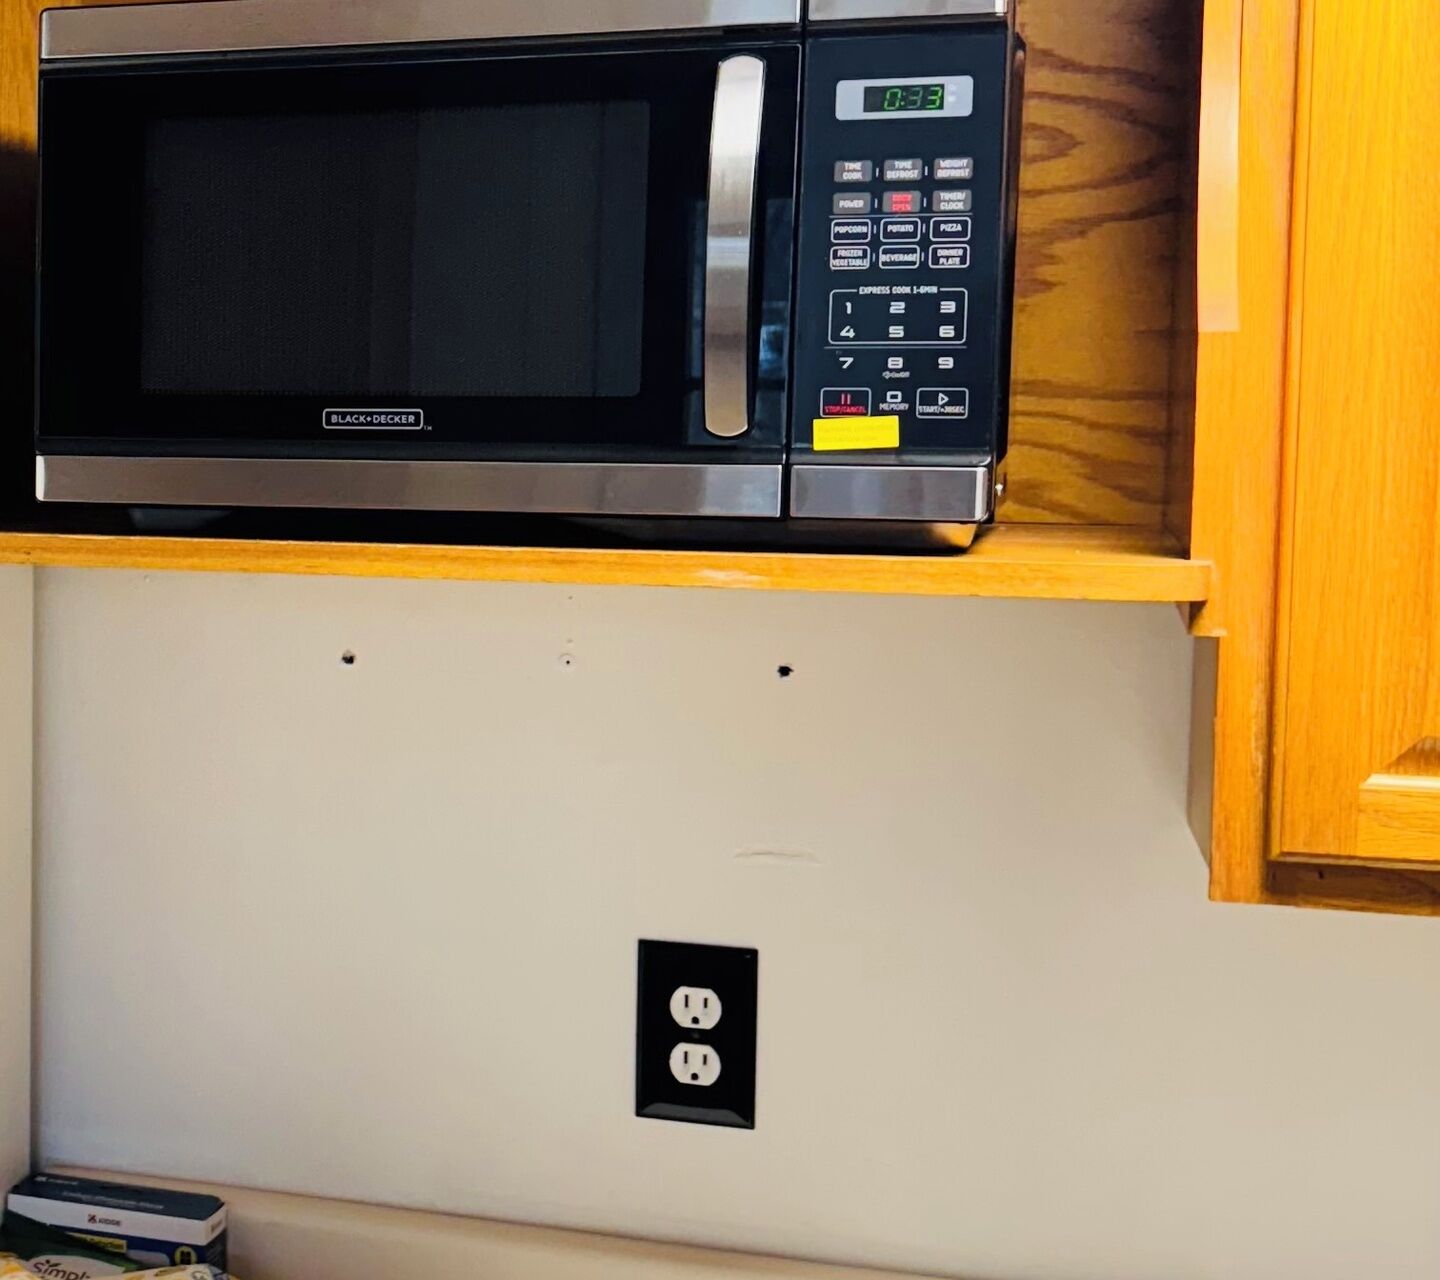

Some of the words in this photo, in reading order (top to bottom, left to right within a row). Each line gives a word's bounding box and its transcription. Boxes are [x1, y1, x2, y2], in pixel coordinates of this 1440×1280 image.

[884, 87, 942, 110] 0:33
[844, 162, 862, 170] TIME
[894, 161, 912, 169] TIME
[886, 170, 919, 179] DEFROST
[839, 200, 864, 208] POWER
[940, 202, 964, 210] CLOCK
[834, 226, 867, 234] POPCORN
[940, 224, 962, 232] PIZZA
[837, 249, 863, 257] FROZEN
[881, 254, 918, 262] BEVERAGE
[939, 257, 960, 265] PLATE
[859, 286, 890, 294] EXPRESS
[892, 286, 911, 294] COOK
[845, 302, 852, 314] 1
[889, 301, 906, 314] 2
[940, 301, 956, 313] 3
[839, 325, 856, 338] 4
[888, 325, 905, 338] 5
[938, 325, 955, 338] 6
[839, 357, 854, 369] 7
[888, 357, 903, 369] 8
[938, 357, 954, 369] 9
[886, 391, 902, 403] 0
[879, 403, 909, 412] MEMORY
